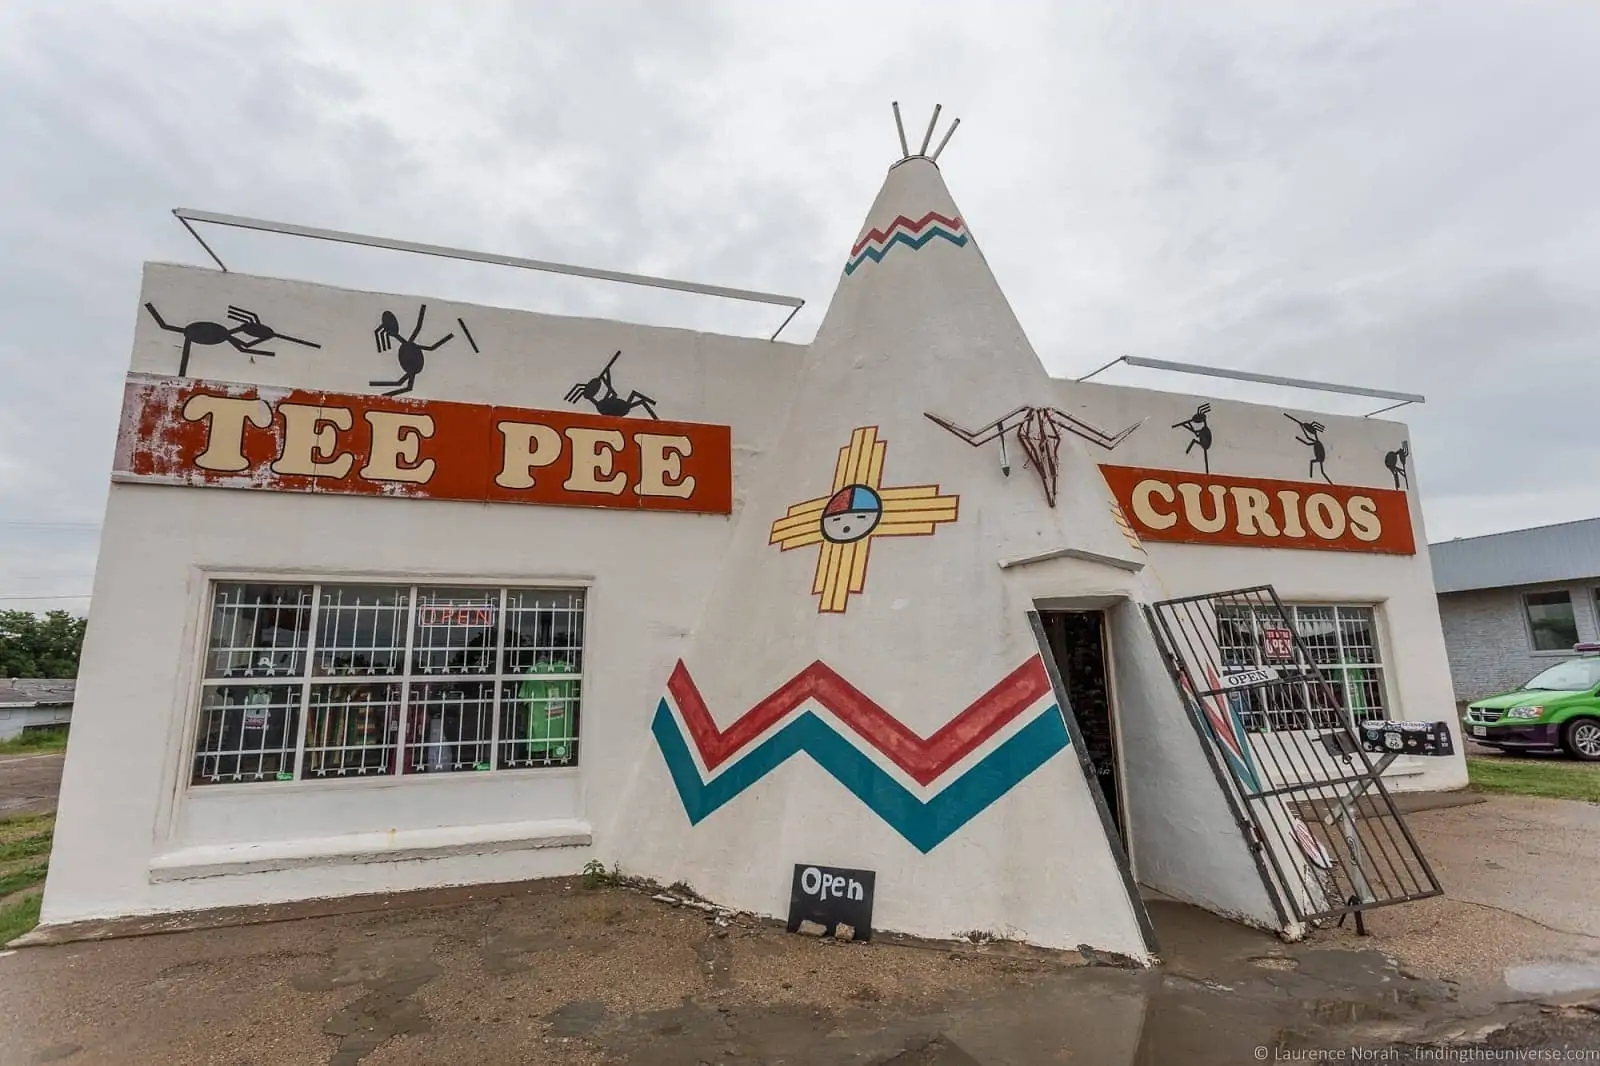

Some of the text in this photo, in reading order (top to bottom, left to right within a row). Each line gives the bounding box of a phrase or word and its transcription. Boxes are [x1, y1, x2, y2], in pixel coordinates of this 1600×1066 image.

[183, 394, 696, 499] TEE PEE
[1131, 479, 1382, 542] CURIOS
[421, 607, 492, 625] OPEN
[1229, 669, 1269, 686] OPEN
[801, 867, 864, 902] Open
